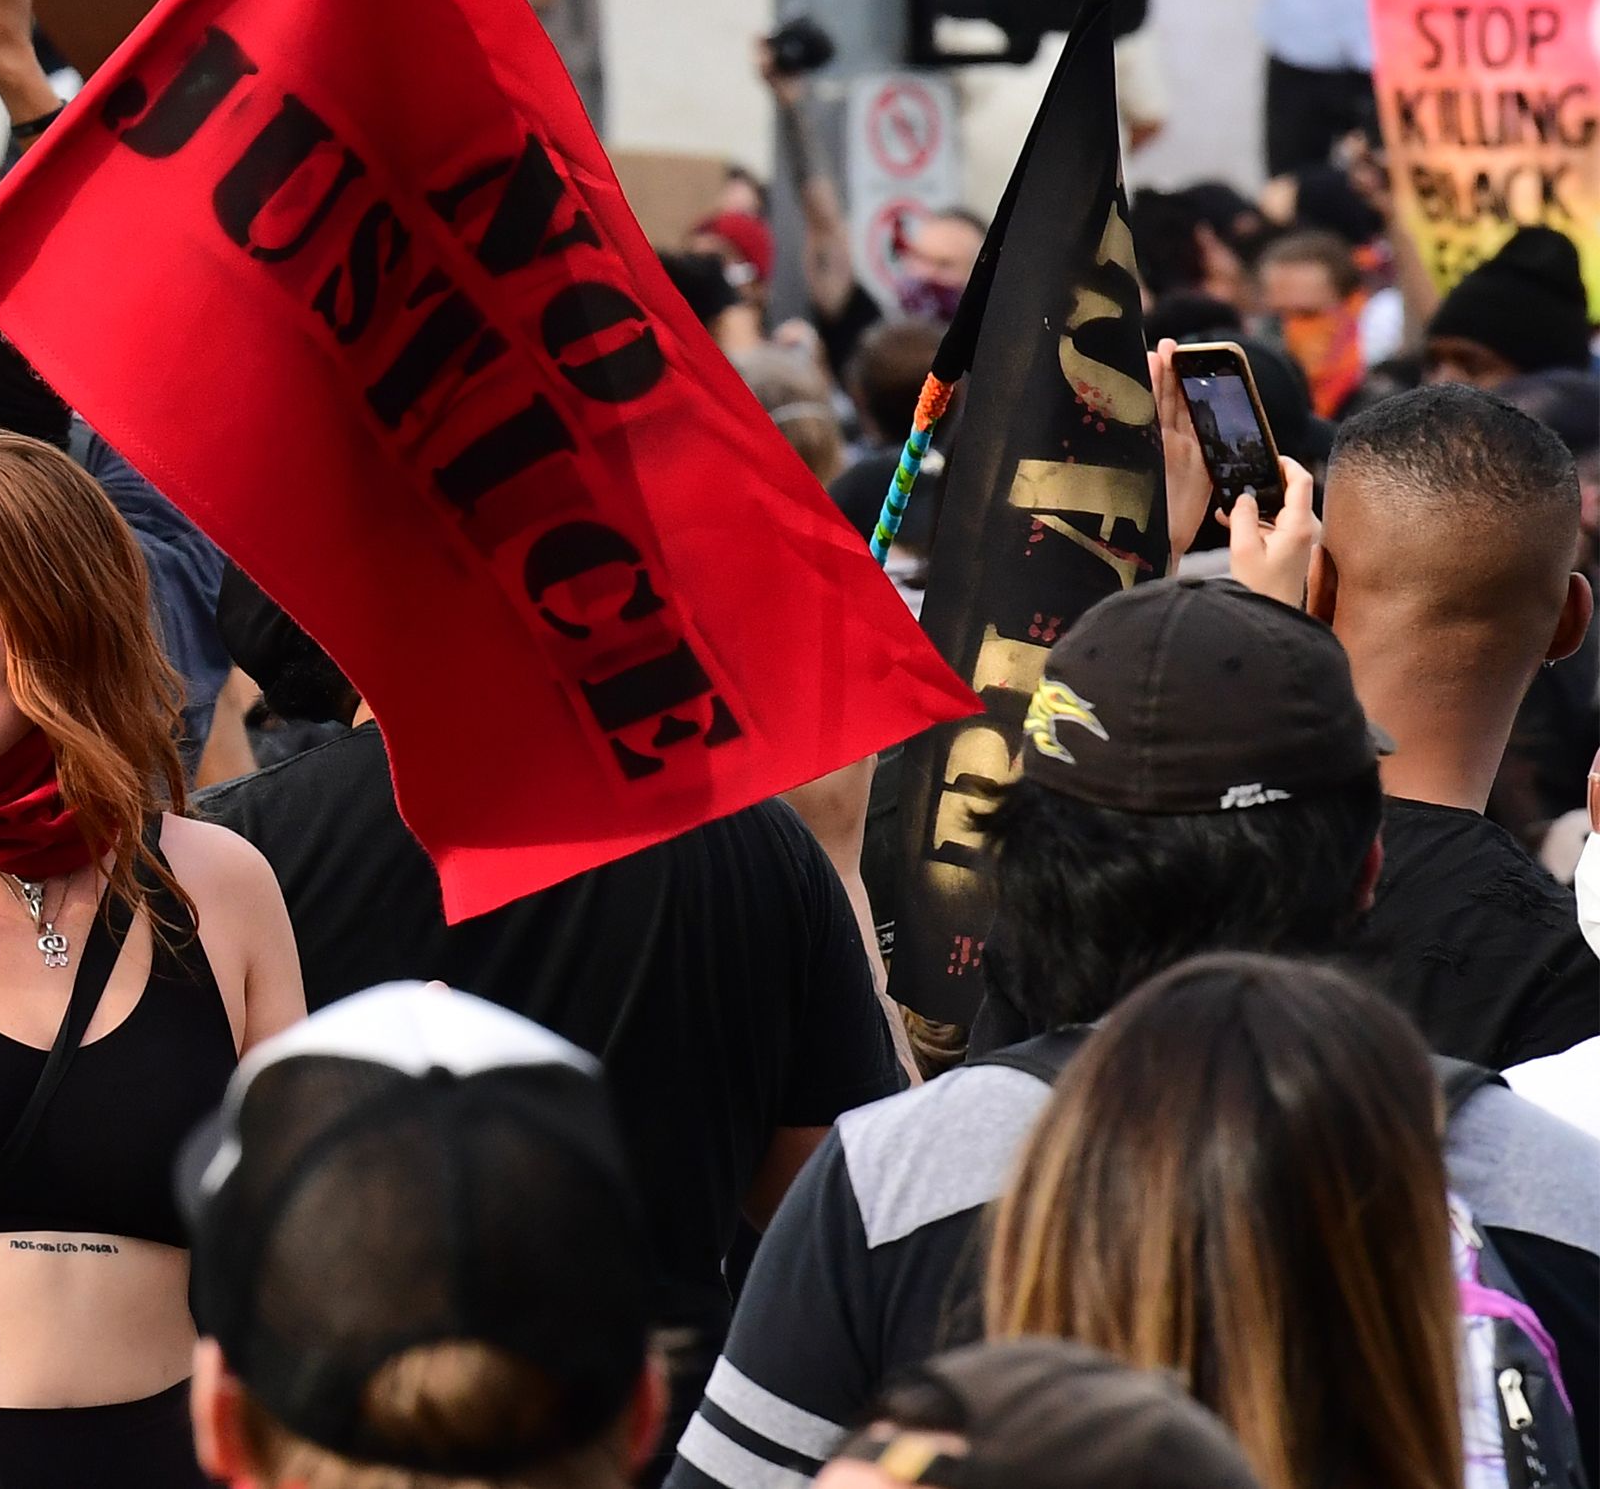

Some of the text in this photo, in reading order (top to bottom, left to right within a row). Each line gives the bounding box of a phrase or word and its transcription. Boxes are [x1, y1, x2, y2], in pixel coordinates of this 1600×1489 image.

[1395, 83, 1597, 148] KILLING
[1415, 6, 1560, 70] STOP
[426, 133, 668, 404] NO
[106, 25, 742, 781] JUSTICE
